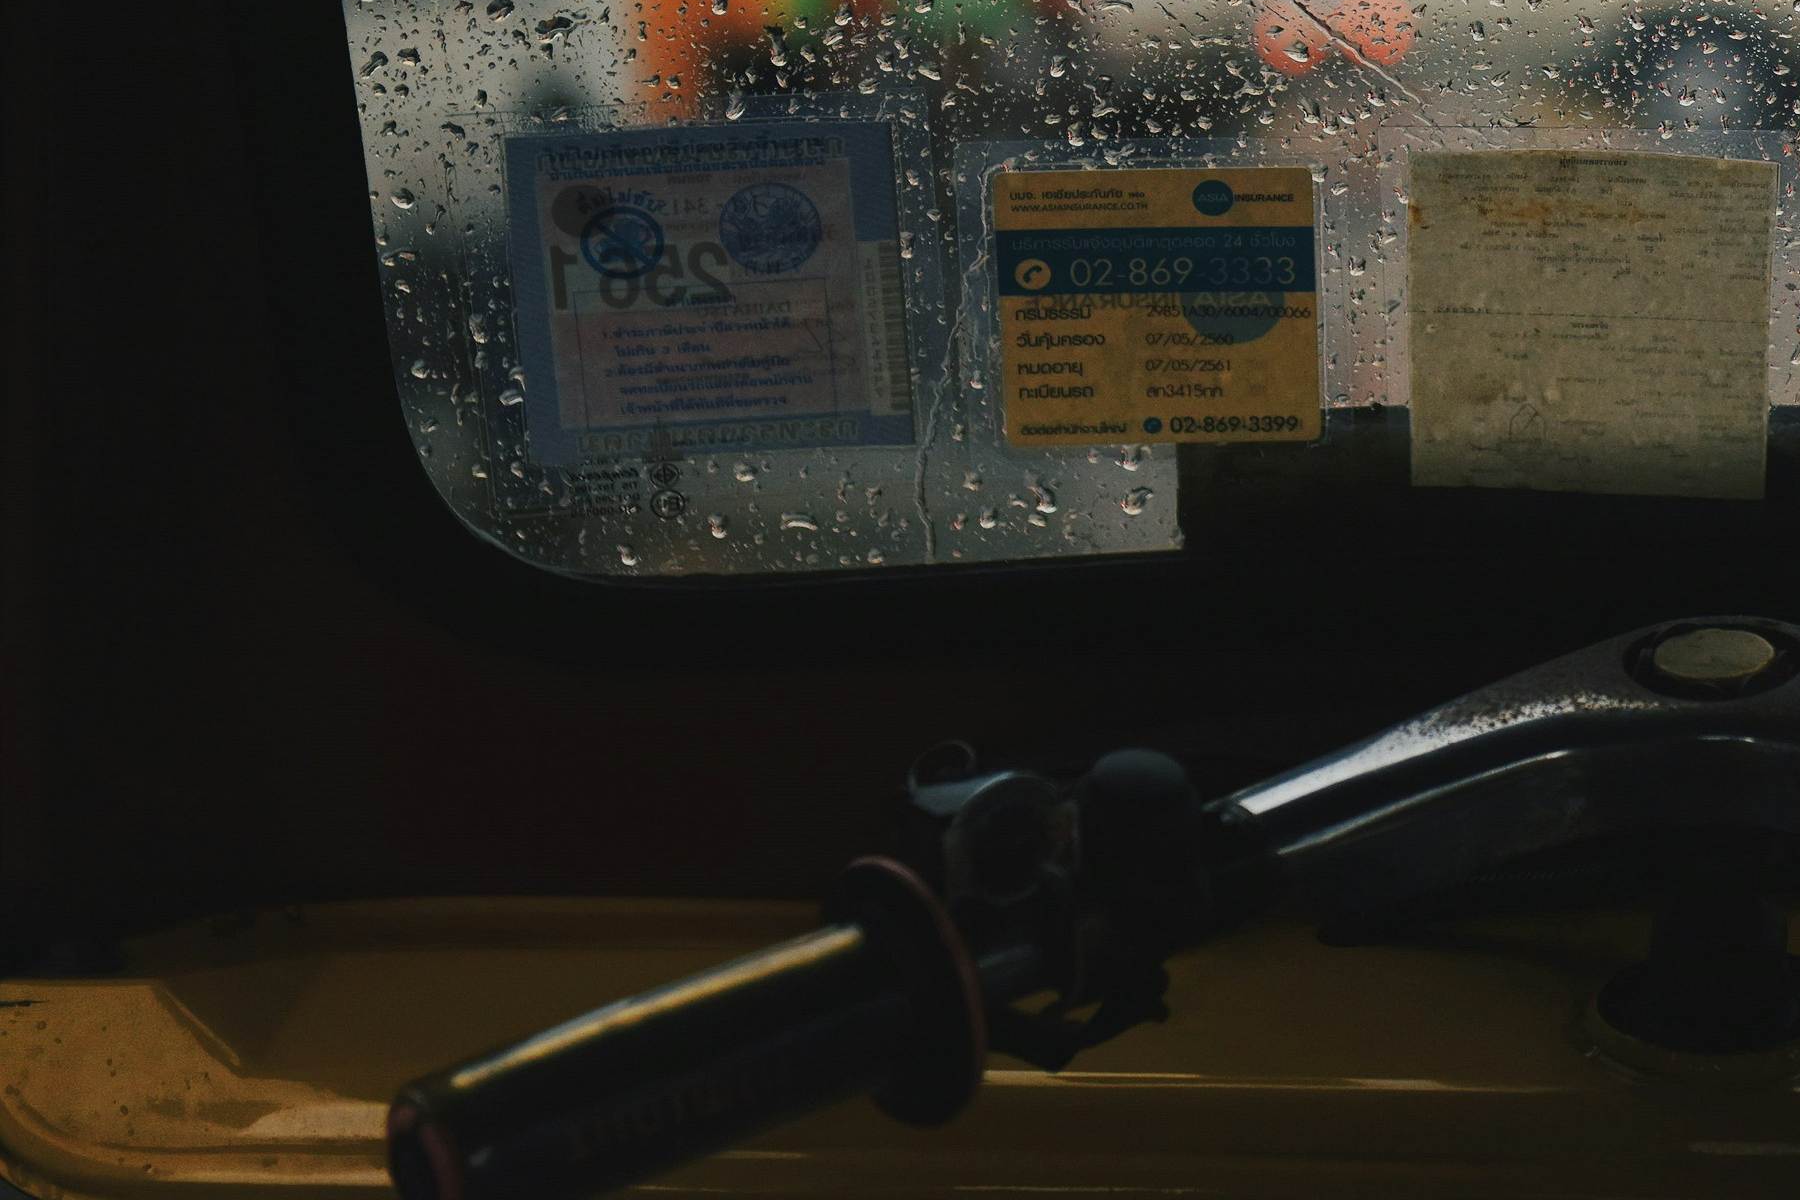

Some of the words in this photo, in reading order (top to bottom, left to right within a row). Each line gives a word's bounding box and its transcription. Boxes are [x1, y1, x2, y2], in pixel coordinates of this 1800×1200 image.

[1234, 193, 1295, 203] INSURANCE
[1223, 235, 1243, 248] 24
[1250, 232, 1296, 249] ชั่วโมง
[1070, 256, 1297, 287] 02-869-3333
[1015, 304, 1092, 321] กรมธรรม์
[1016, 332, 1106, 349] วันคุ้มครอง
[1145, 333, 1234, 347] 07/05/2560
[1018, 362, 1084, 378] หมดอายุ
[1145, 359, 1232, 373] 07/05/2561
[1019, 384, 1094, 400] ทะเบียนรถ
[1170, 417, 1299, 434] 02-869-3399
